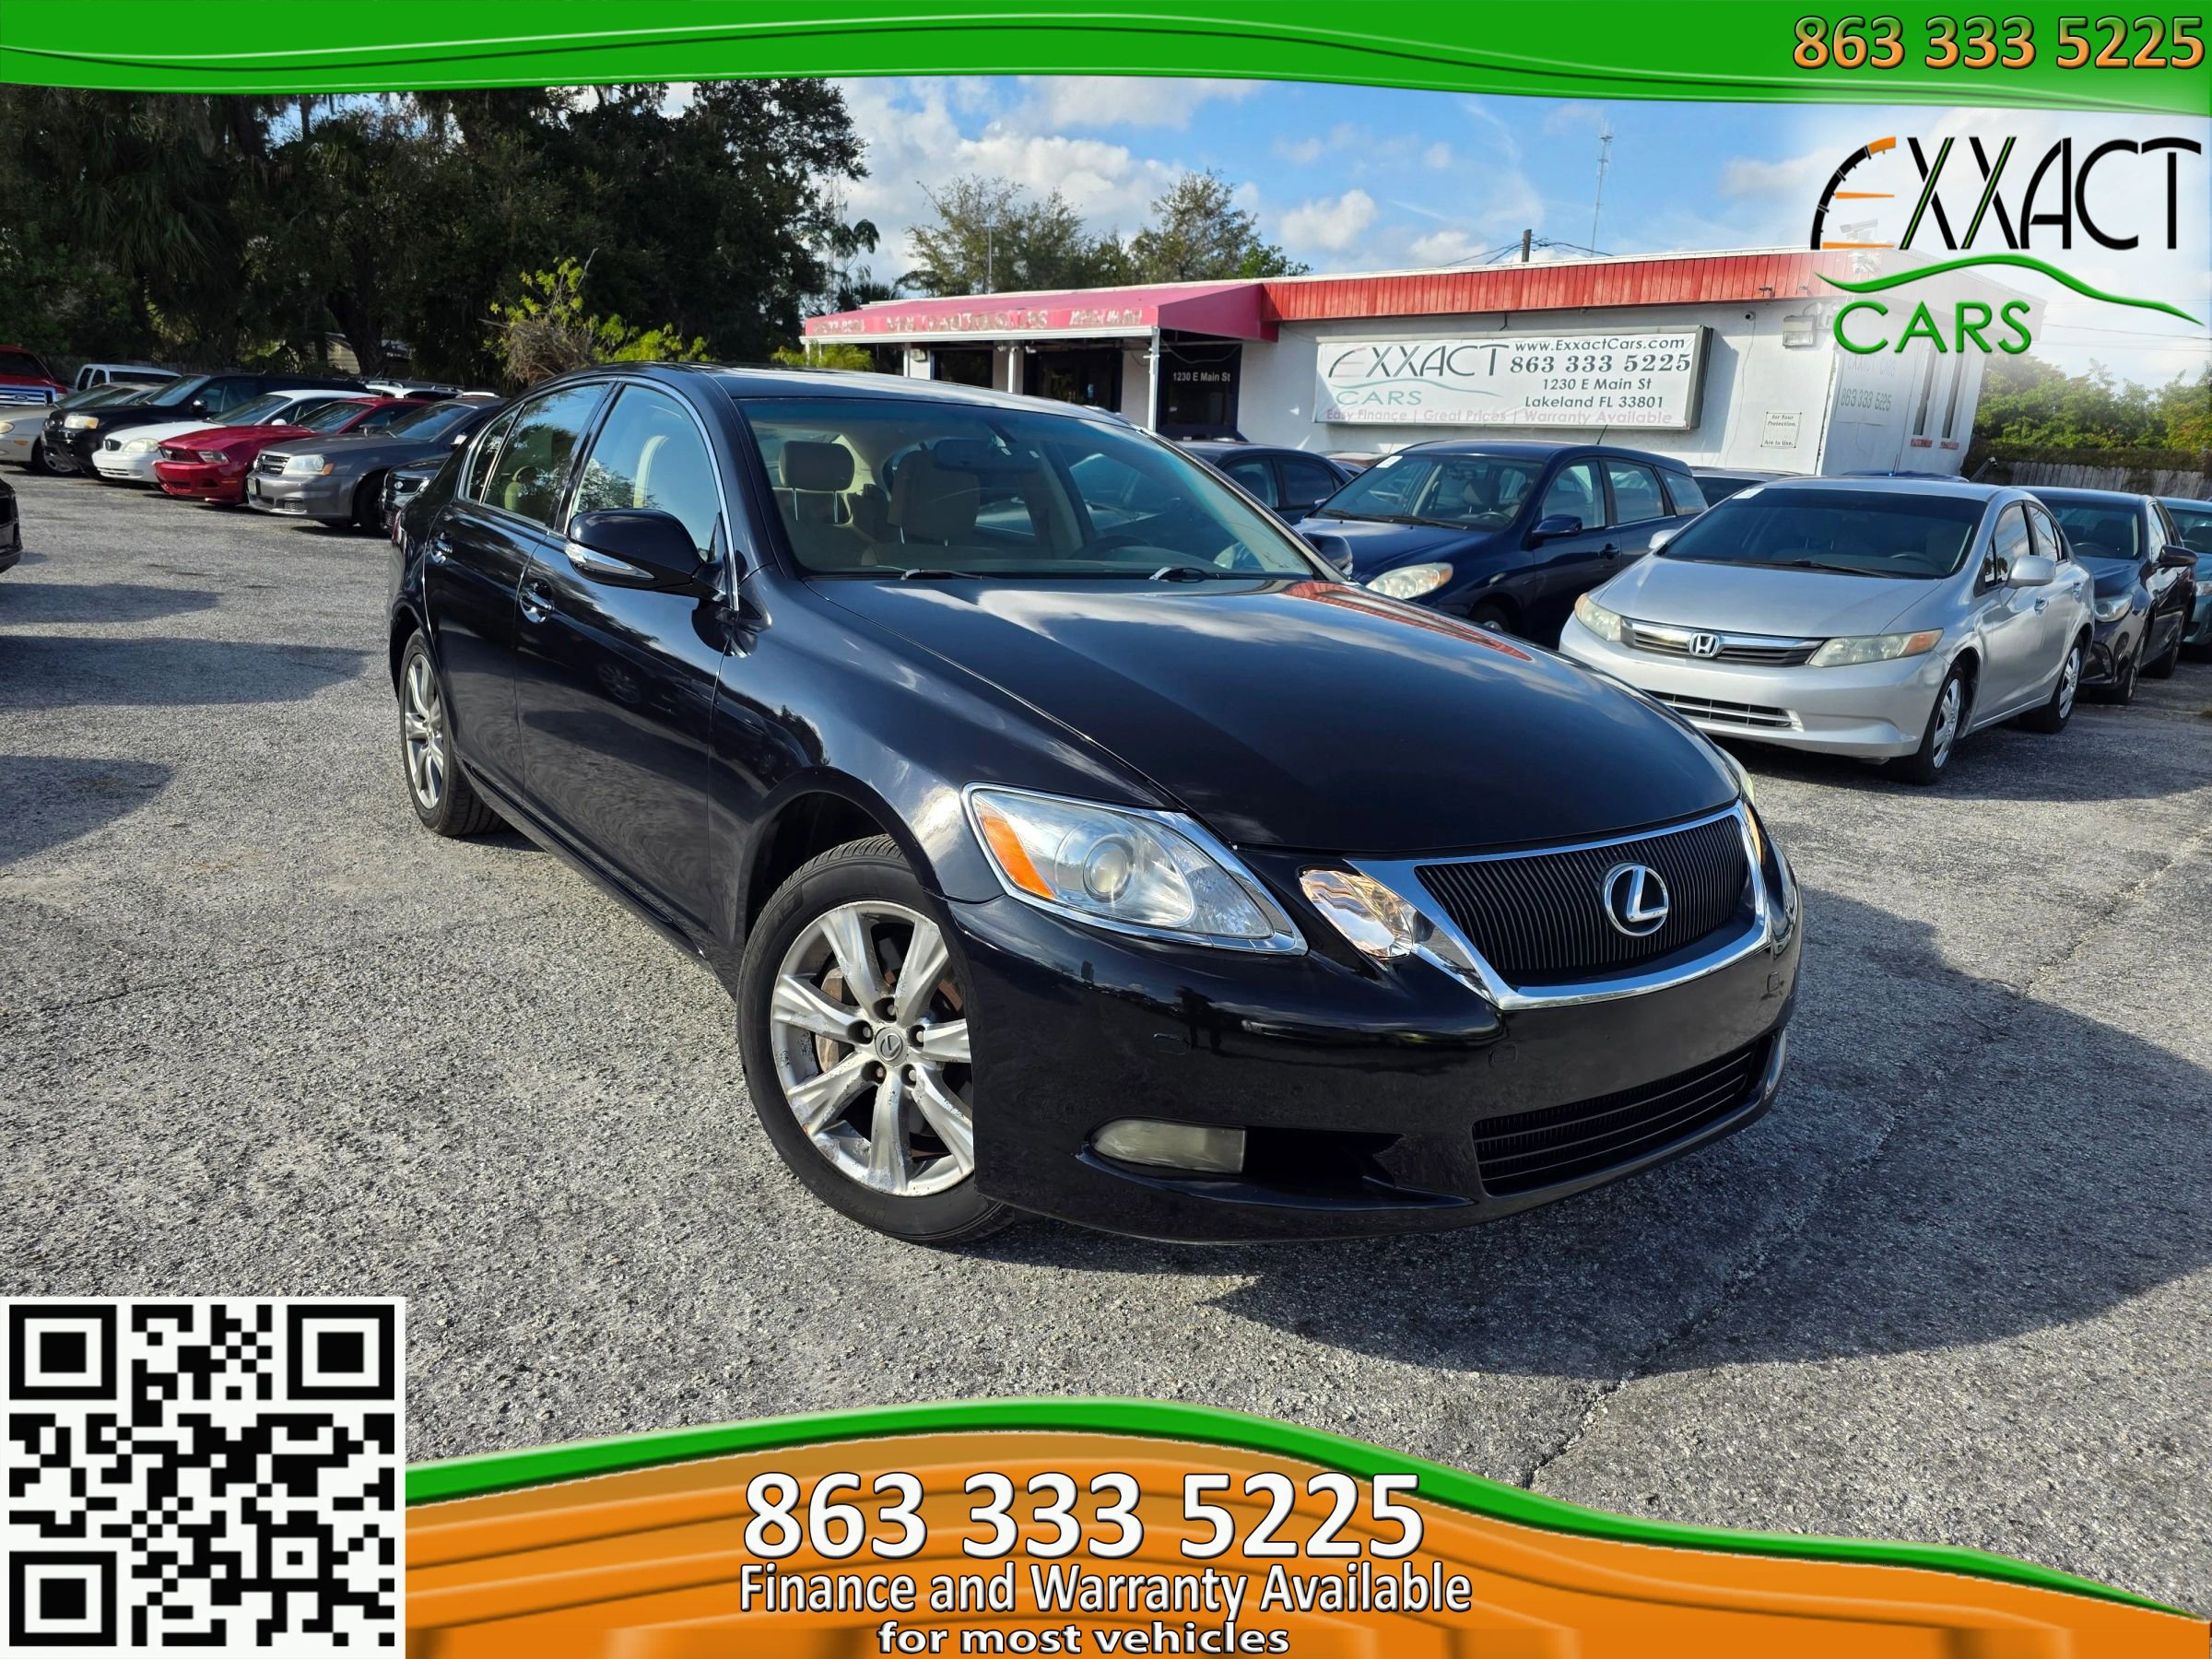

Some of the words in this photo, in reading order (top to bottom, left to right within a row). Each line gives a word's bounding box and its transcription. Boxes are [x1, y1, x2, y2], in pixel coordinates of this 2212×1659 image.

[1515, 338, 1685, 352] www.ExxactCars.com
[1328, 345, 1509, 378] EXXACT
[1510, 356, 1555, 373] 863
[1565, 355, 1613, 372] 333
[1624, 353, 1690, 371] 5225
[1173, 371, 1191, 382] 1230
[1193, 371, 1199, 382] E
[1201, 371, 1219, 382] Main
[1222, 371, 1231, 382] St
[1543, 379, 1576, 390] 1230
[1582, 379, 1589, 390] E
[1594, 379, 1632, 390] Main
[1638, 378, 1652, 390] St
[1336, 391, 1422, 406] CARS
[1525, 396, 1594, 407] Lakeland
[1599, 396, 1613, 407] FL
[1618, 396, 1663, 407] 33801
[1326, 409, 1352, 423] Easy
[1358, 409, 1407, 422] Finance
[1424, 410, 1463, 422] Great
[1466, 410, 1506, 422] Prices
[1524, 411, 1591, 425] Warranty
[1597, 411, 1673, 424] Available
